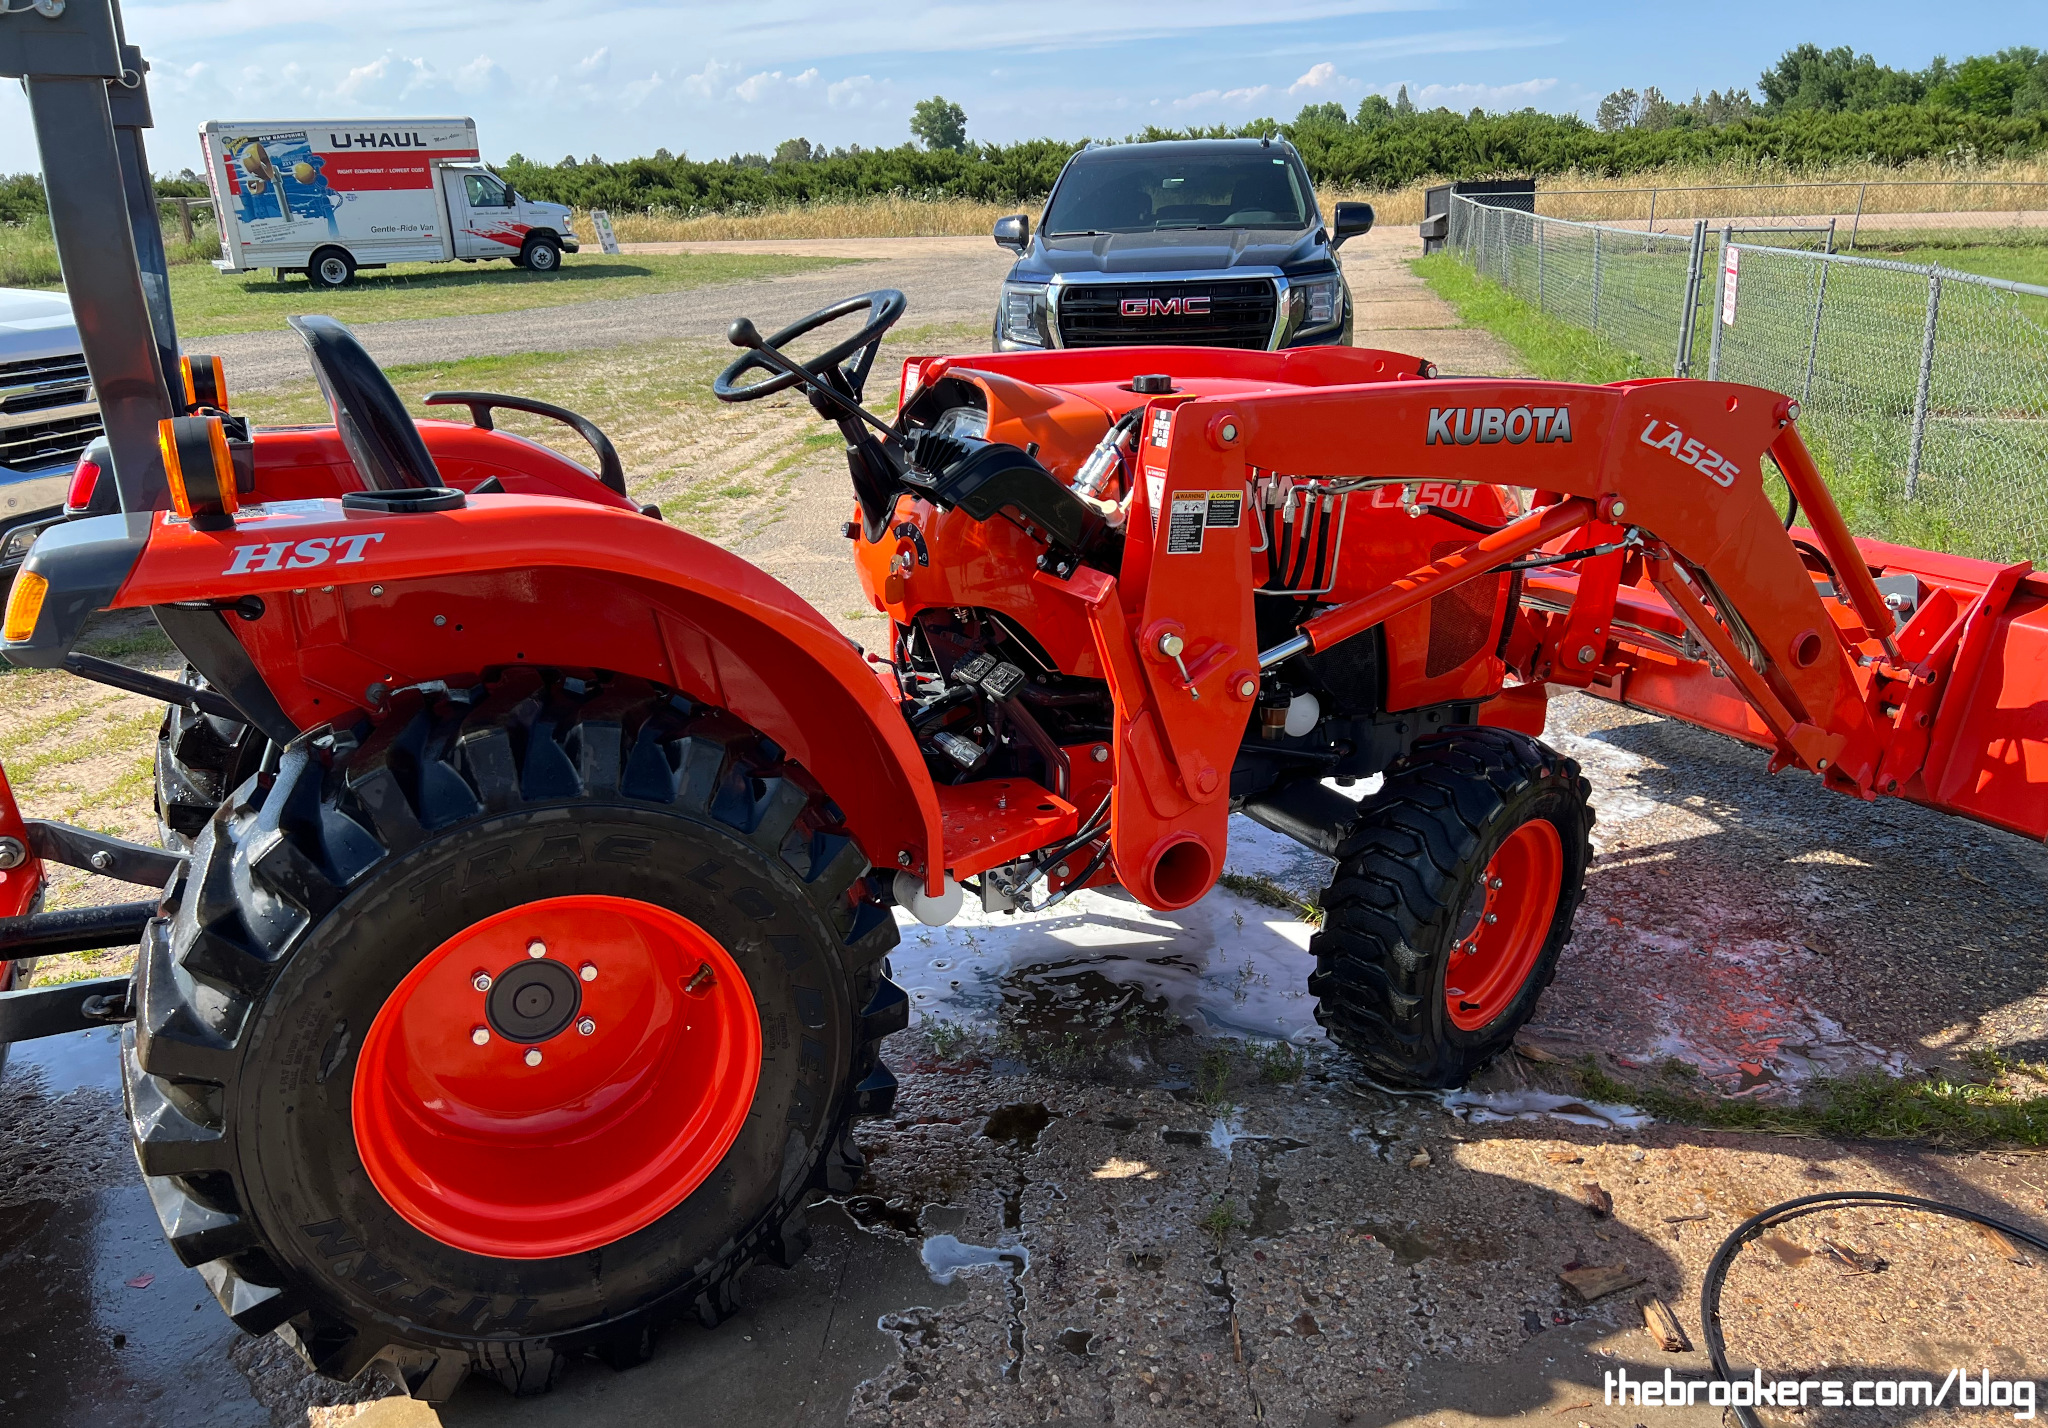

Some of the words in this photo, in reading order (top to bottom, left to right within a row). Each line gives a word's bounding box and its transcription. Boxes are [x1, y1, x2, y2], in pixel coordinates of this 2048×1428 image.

[420, 223, 434, 231] Van
[1120, 296, 1211, 317] GMC
[1425, 406, 1573, 446] KUBOTA
[1639, 419, 1741, 489] LA525
[221, 532, 386, 576] HST
